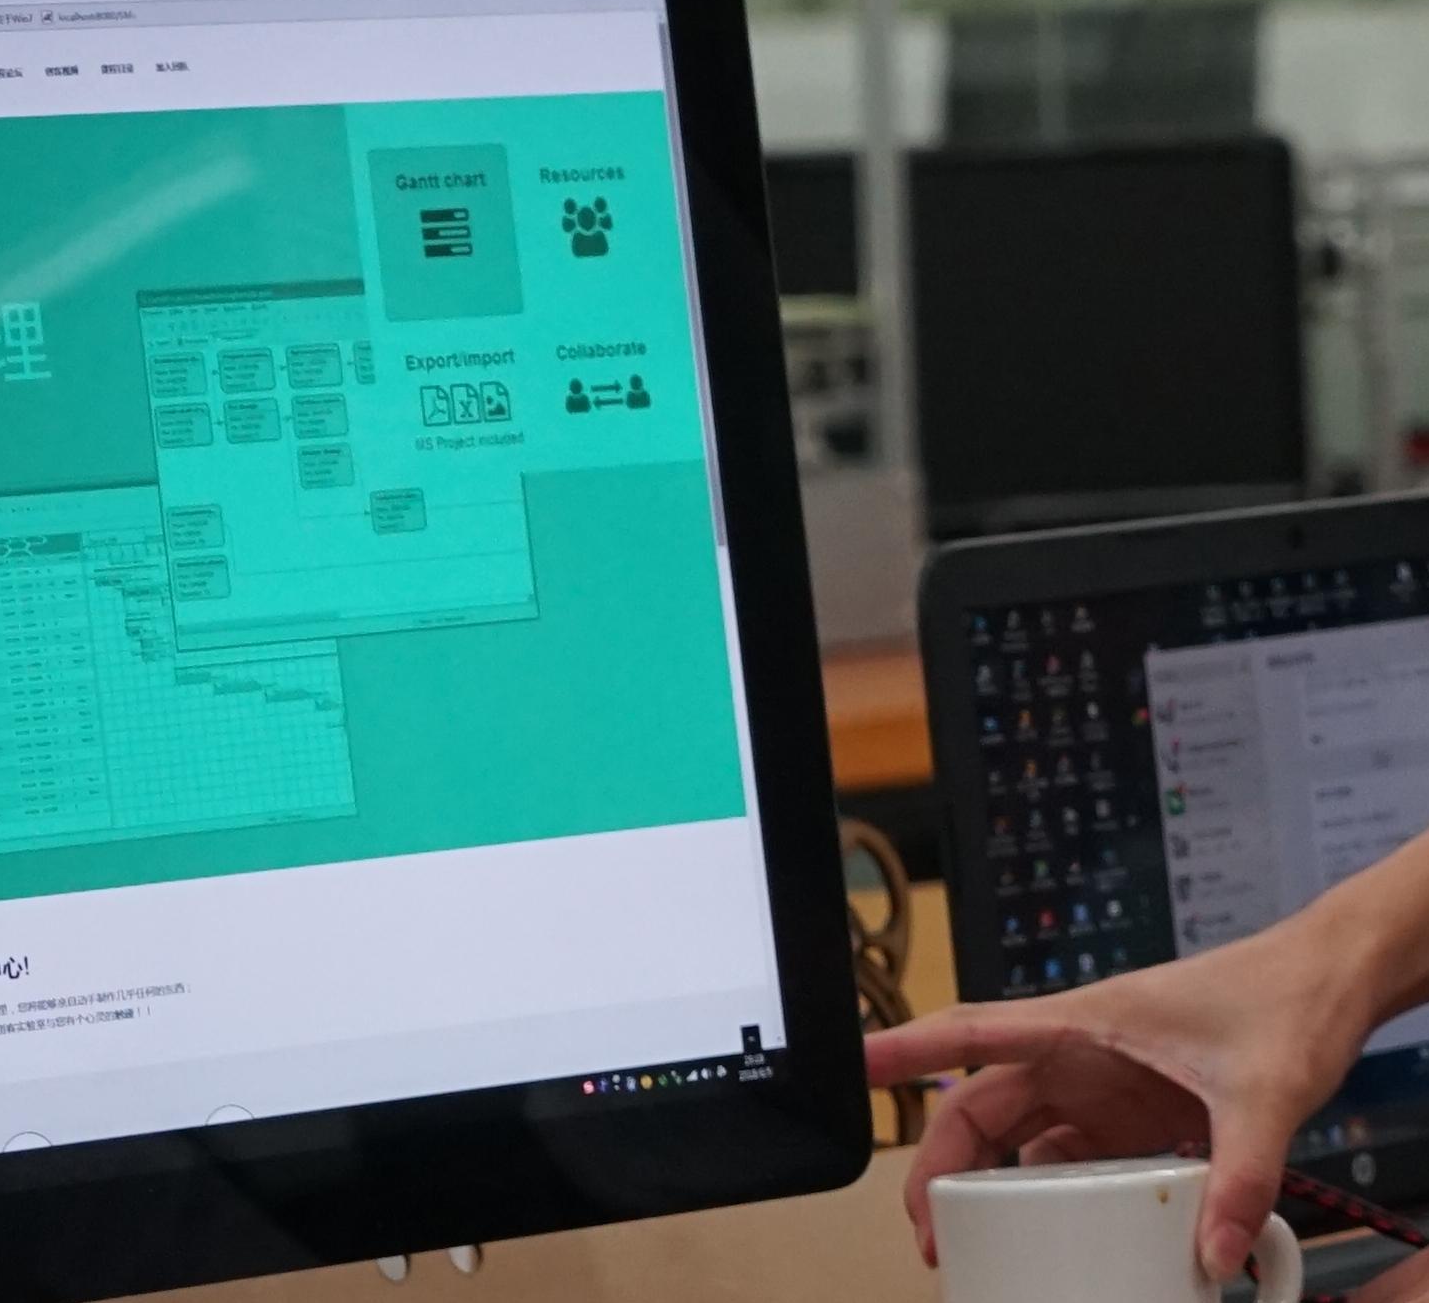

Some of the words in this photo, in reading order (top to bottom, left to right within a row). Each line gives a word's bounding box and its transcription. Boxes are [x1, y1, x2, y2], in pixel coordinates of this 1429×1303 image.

[396, 173, 440, 190] Gantt
[444, 171, 487, 188] chart
[539, 166, 625, 185] Resources
[556, 341, 647, 361] Collaborate
[405, 348, 516, 374] Export/import
[437, 434, 476, 451] Project
